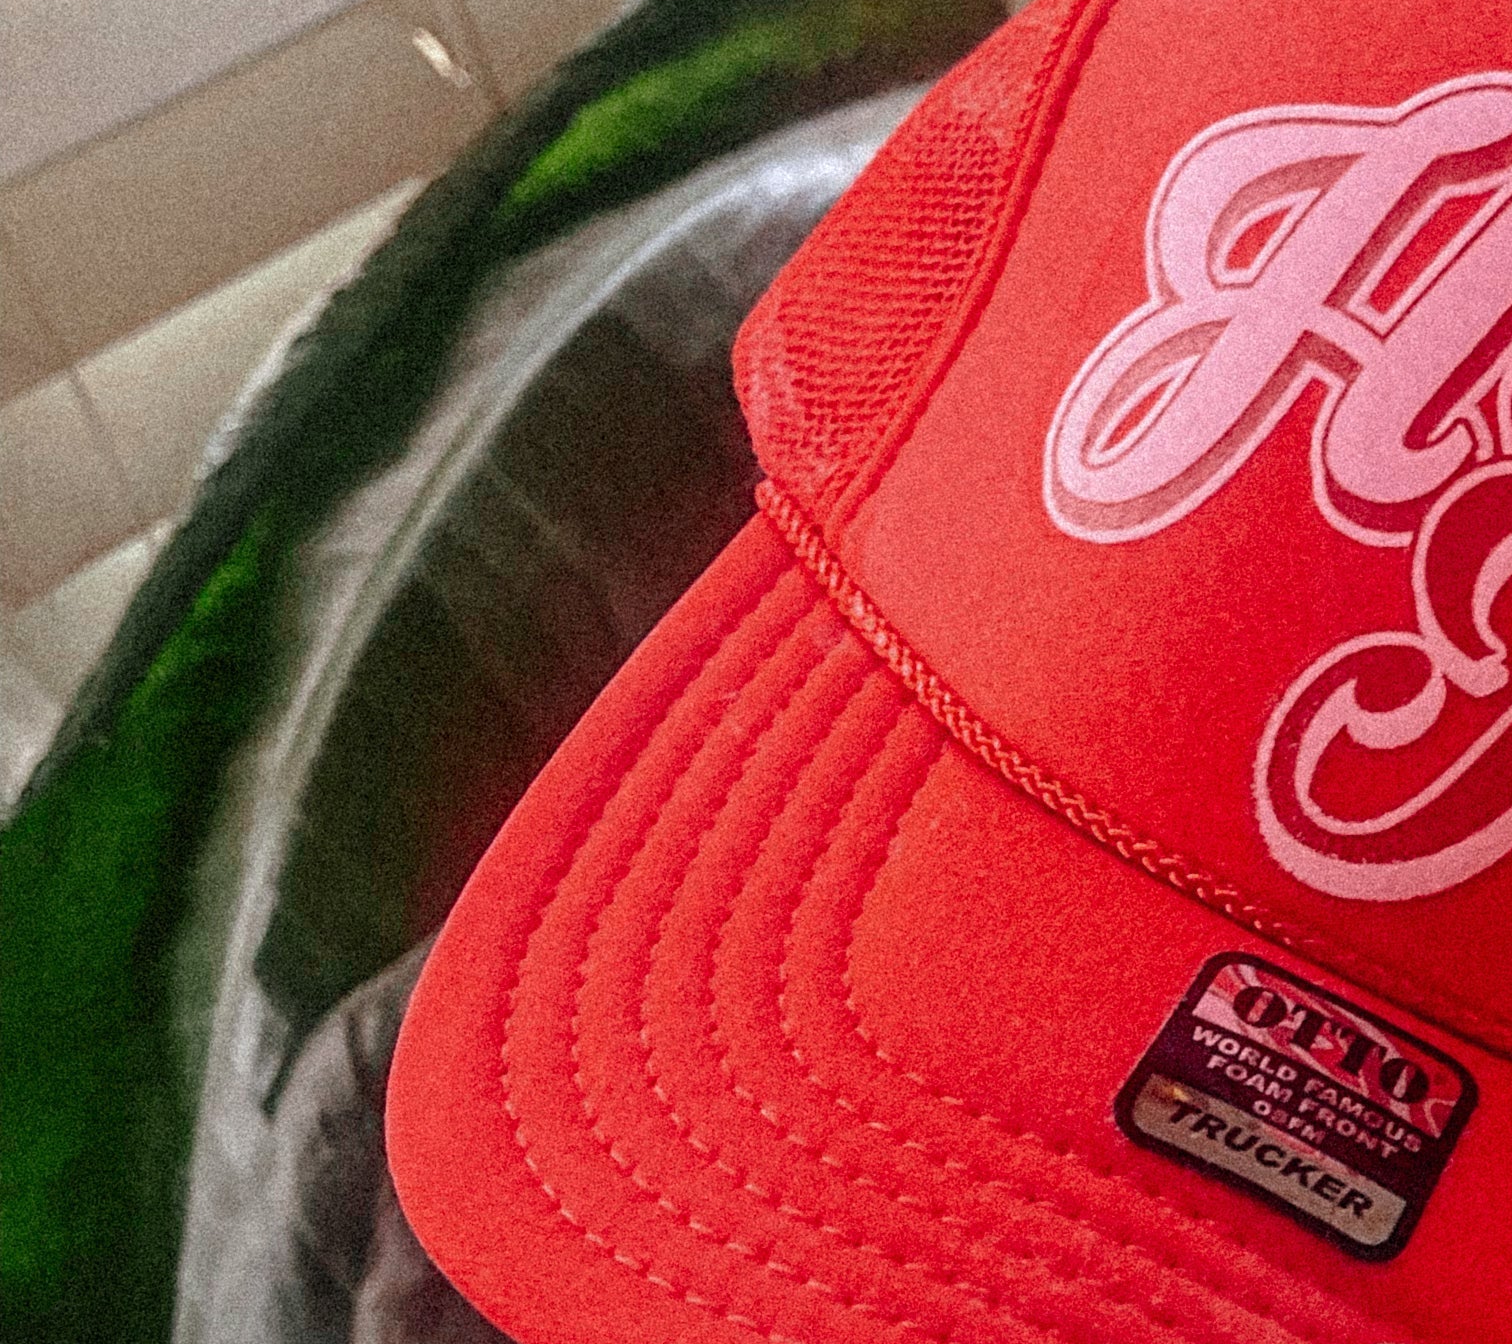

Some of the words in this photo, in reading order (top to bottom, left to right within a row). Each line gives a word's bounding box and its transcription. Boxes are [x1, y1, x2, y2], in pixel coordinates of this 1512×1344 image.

[1192, 1025, 1296, 1081] WORLD
[1304, 1078, 1422, 1153] FAMOUS
[1233, 986, 1430, 1104] OTTO
[1170, 1099, 1374, 1220] TRUCKER
[1206, 1055, 1293, 1104] FOAM
[1299, 1099, 1400, 1159] FRONT
[1253, 1100, 1325, 1145] OSFM
